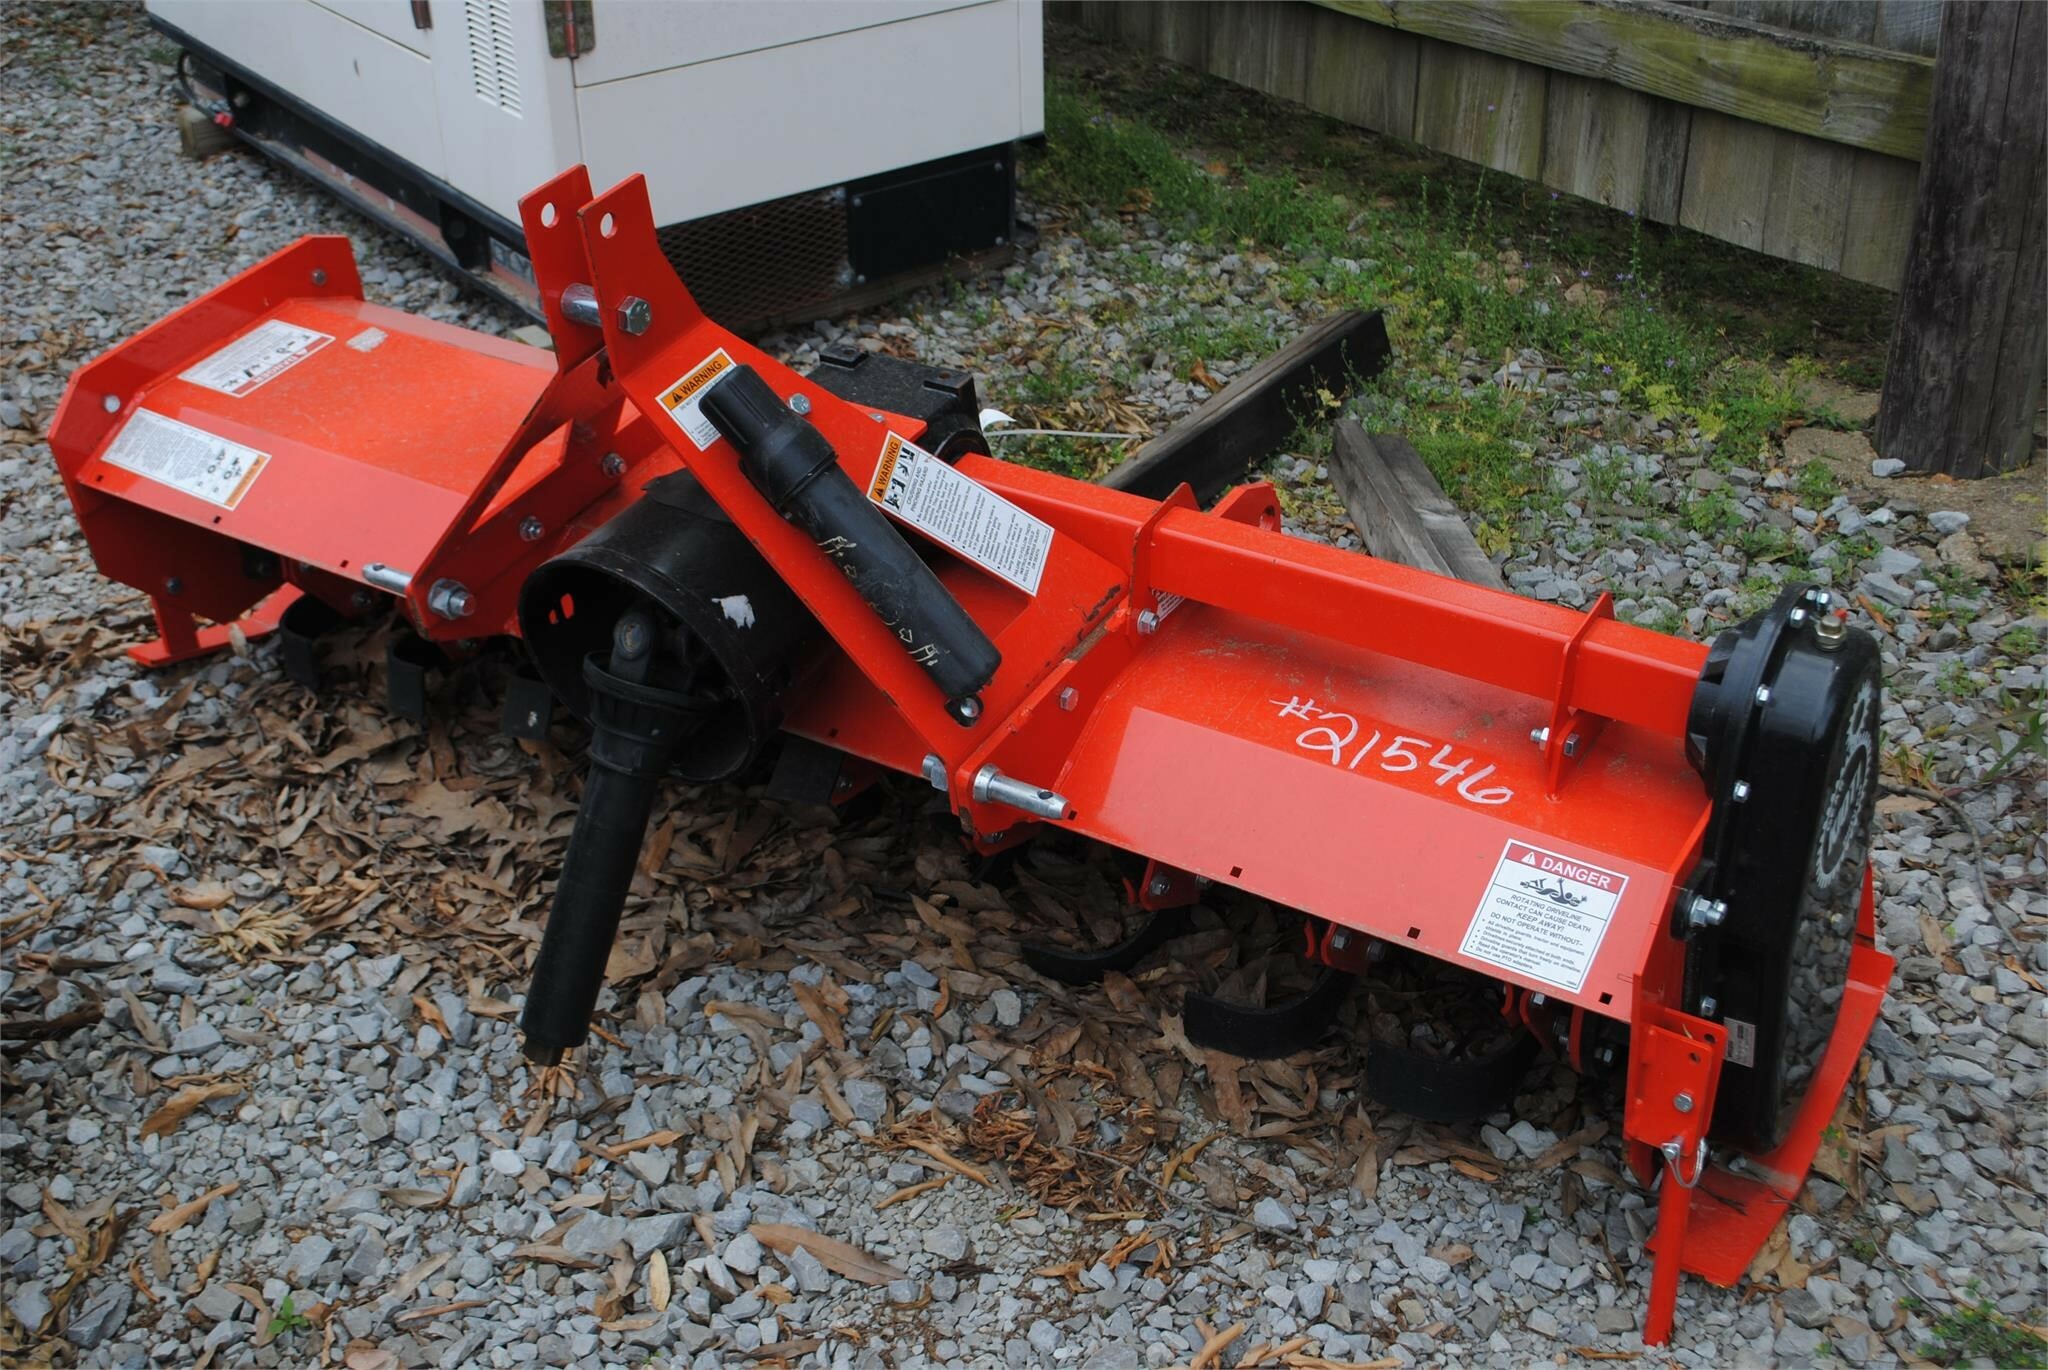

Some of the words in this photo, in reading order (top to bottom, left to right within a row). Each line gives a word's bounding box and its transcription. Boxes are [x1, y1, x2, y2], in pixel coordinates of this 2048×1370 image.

[680, 360, 722, 395] WARNING
[877, 441, 899, 488] WARNING
[906, 478, 918, 506] CRUSHING
[911, 487, 922, 513] PINCHING
[918, 465, 929, 488] HAZARD
[1269, 695, 1514, 805] #21546
[1540, 856, 1612, 889] DANGER
[1490, 911, 1501, 920] DO
[1501, 915, 1516, 925] NOT
[1516, 920, 1549, 936] OPERATE
[1496, 897, 1528, 912] CONTACT
[1528, 908, 1544, 917] CAN
[1544, 913, 1567, 925] CAUSE
[1568, 921, 1592, 933] DEATH
[1510, 894, 1546, 910] ROTATING
[1546, 906, 1582, 922] DRIVELINE
[1516, 912, 1538, 924] KEEP
[1538, 919, 1565, 933] AWAY!
